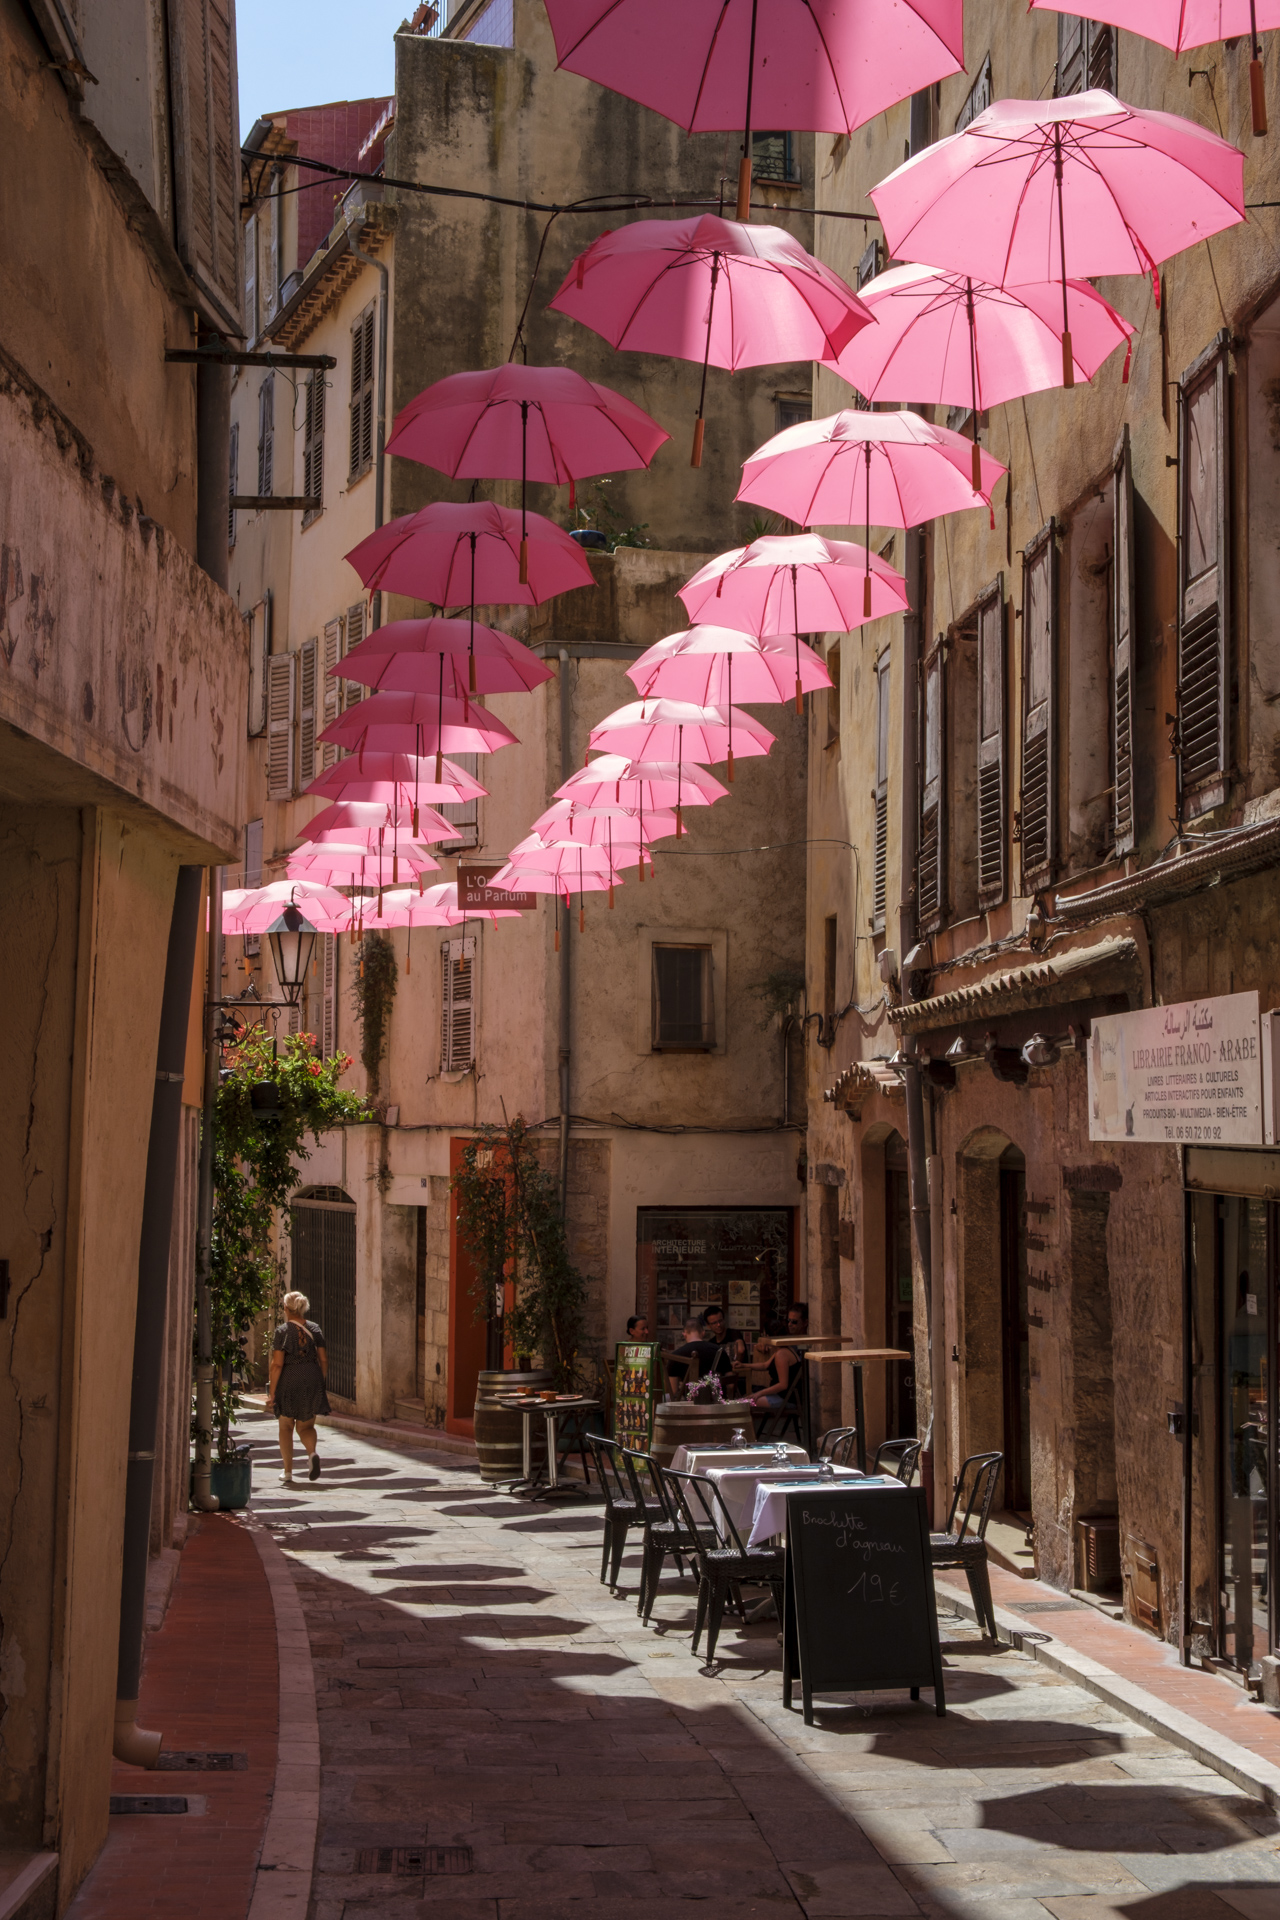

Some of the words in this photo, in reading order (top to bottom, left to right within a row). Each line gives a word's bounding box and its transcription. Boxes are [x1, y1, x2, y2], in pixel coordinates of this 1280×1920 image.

[466, 892, 481, 902] au
[484, 889, 527, 901] Parfum
[1132, 1046, 1173, 1070] LIBRAIRIE
[1175, 1042, 1211, 1067] FRANCO
[1219, 1037, 1257, 1062] ARABE
[1147, 1075, 1164, 1087] LIVRES
[1165, 1072, 1197, 1086] LITTÉRAIRES
[1199, 1072, 1204, 1083] &
[1205, 1070, 1239, 1083] CULTURELS
[1144, 1090, 1167, 1102] ARTICLES
[1167, 1088, 1200, 1101] INTERACTIFS
[1200, 1088, 1217, 1099] POUR
[1217, 1086, 1244, 1099] ENFANTS
[1180, 1107, 1212, 1119] MULTIMEDIA
[1164, 1126, 1174, 1139] Tél.
[1176, 1126, 1184, 1139] 06
[1185, 1126, 1193, 1139] 50
[1194, 1126, 1202, 1139] 72
[1203, 1126, 1212, 1139] 00
[1213, 1126, 1222, 1139] 92
[802, 1510, 868, 1531] Brochette
[835, 1530, 906, 1562] d'agneau
